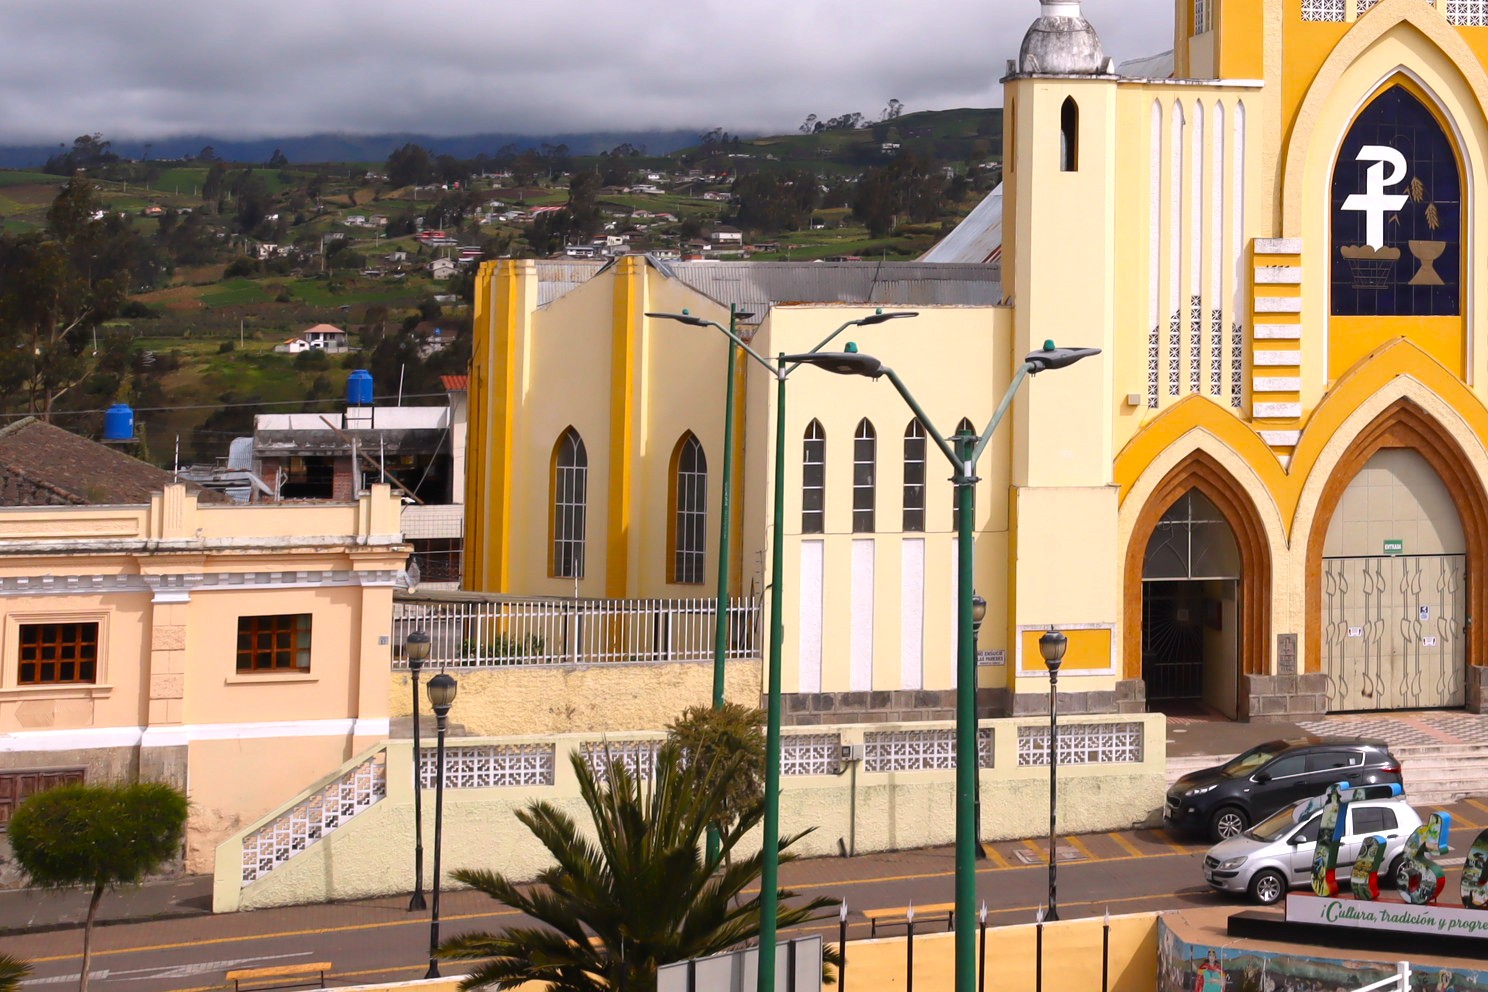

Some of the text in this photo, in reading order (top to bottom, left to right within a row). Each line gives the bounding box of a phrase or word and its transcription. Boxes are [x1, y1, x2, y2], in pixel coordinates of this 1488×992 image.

[1320, 900, 1377, 923] ¡Cultura,
[1380, 909, 1436, 927] tradición
[1437, 918, 1447, 930] y
